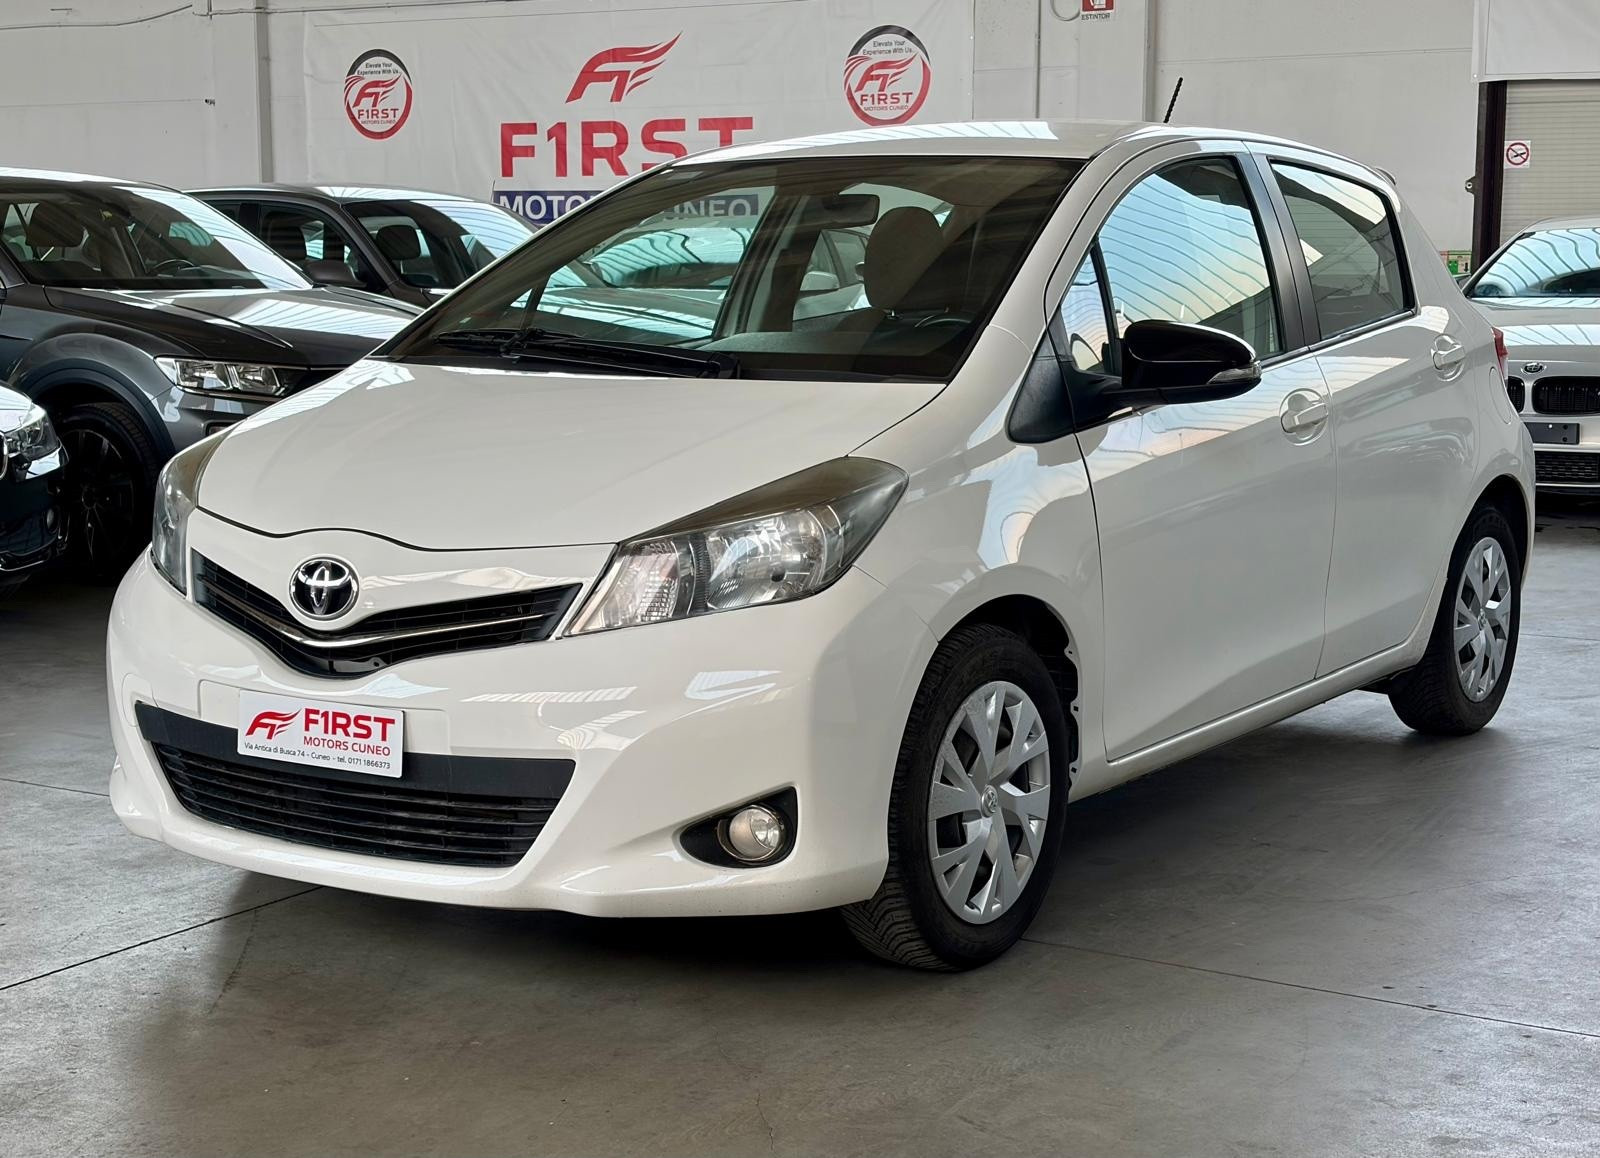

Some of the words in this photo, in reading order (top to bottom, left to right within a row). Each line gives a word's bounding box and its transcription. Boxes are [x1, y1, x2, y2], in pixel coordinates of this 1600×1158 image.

[860, 92, 913, 105] F1RST
[358, 109, 399, 119] F1RST
[501, 117, 753, 177] F1RST
[304, 708, 395, 742] F1RST
[245, 742, 254, 750] Via
[254, 744, 272, 753] Antica
[280, 747, 296, 756] Busca
[311, 752, 331, 760] Cuneo
[348, 757, 362, 765] 0171
[363, 759, 391, 769] 1866373
[303, 736, 349, 751] MOTORS
[351, 743, 391, 757] CUNEO
